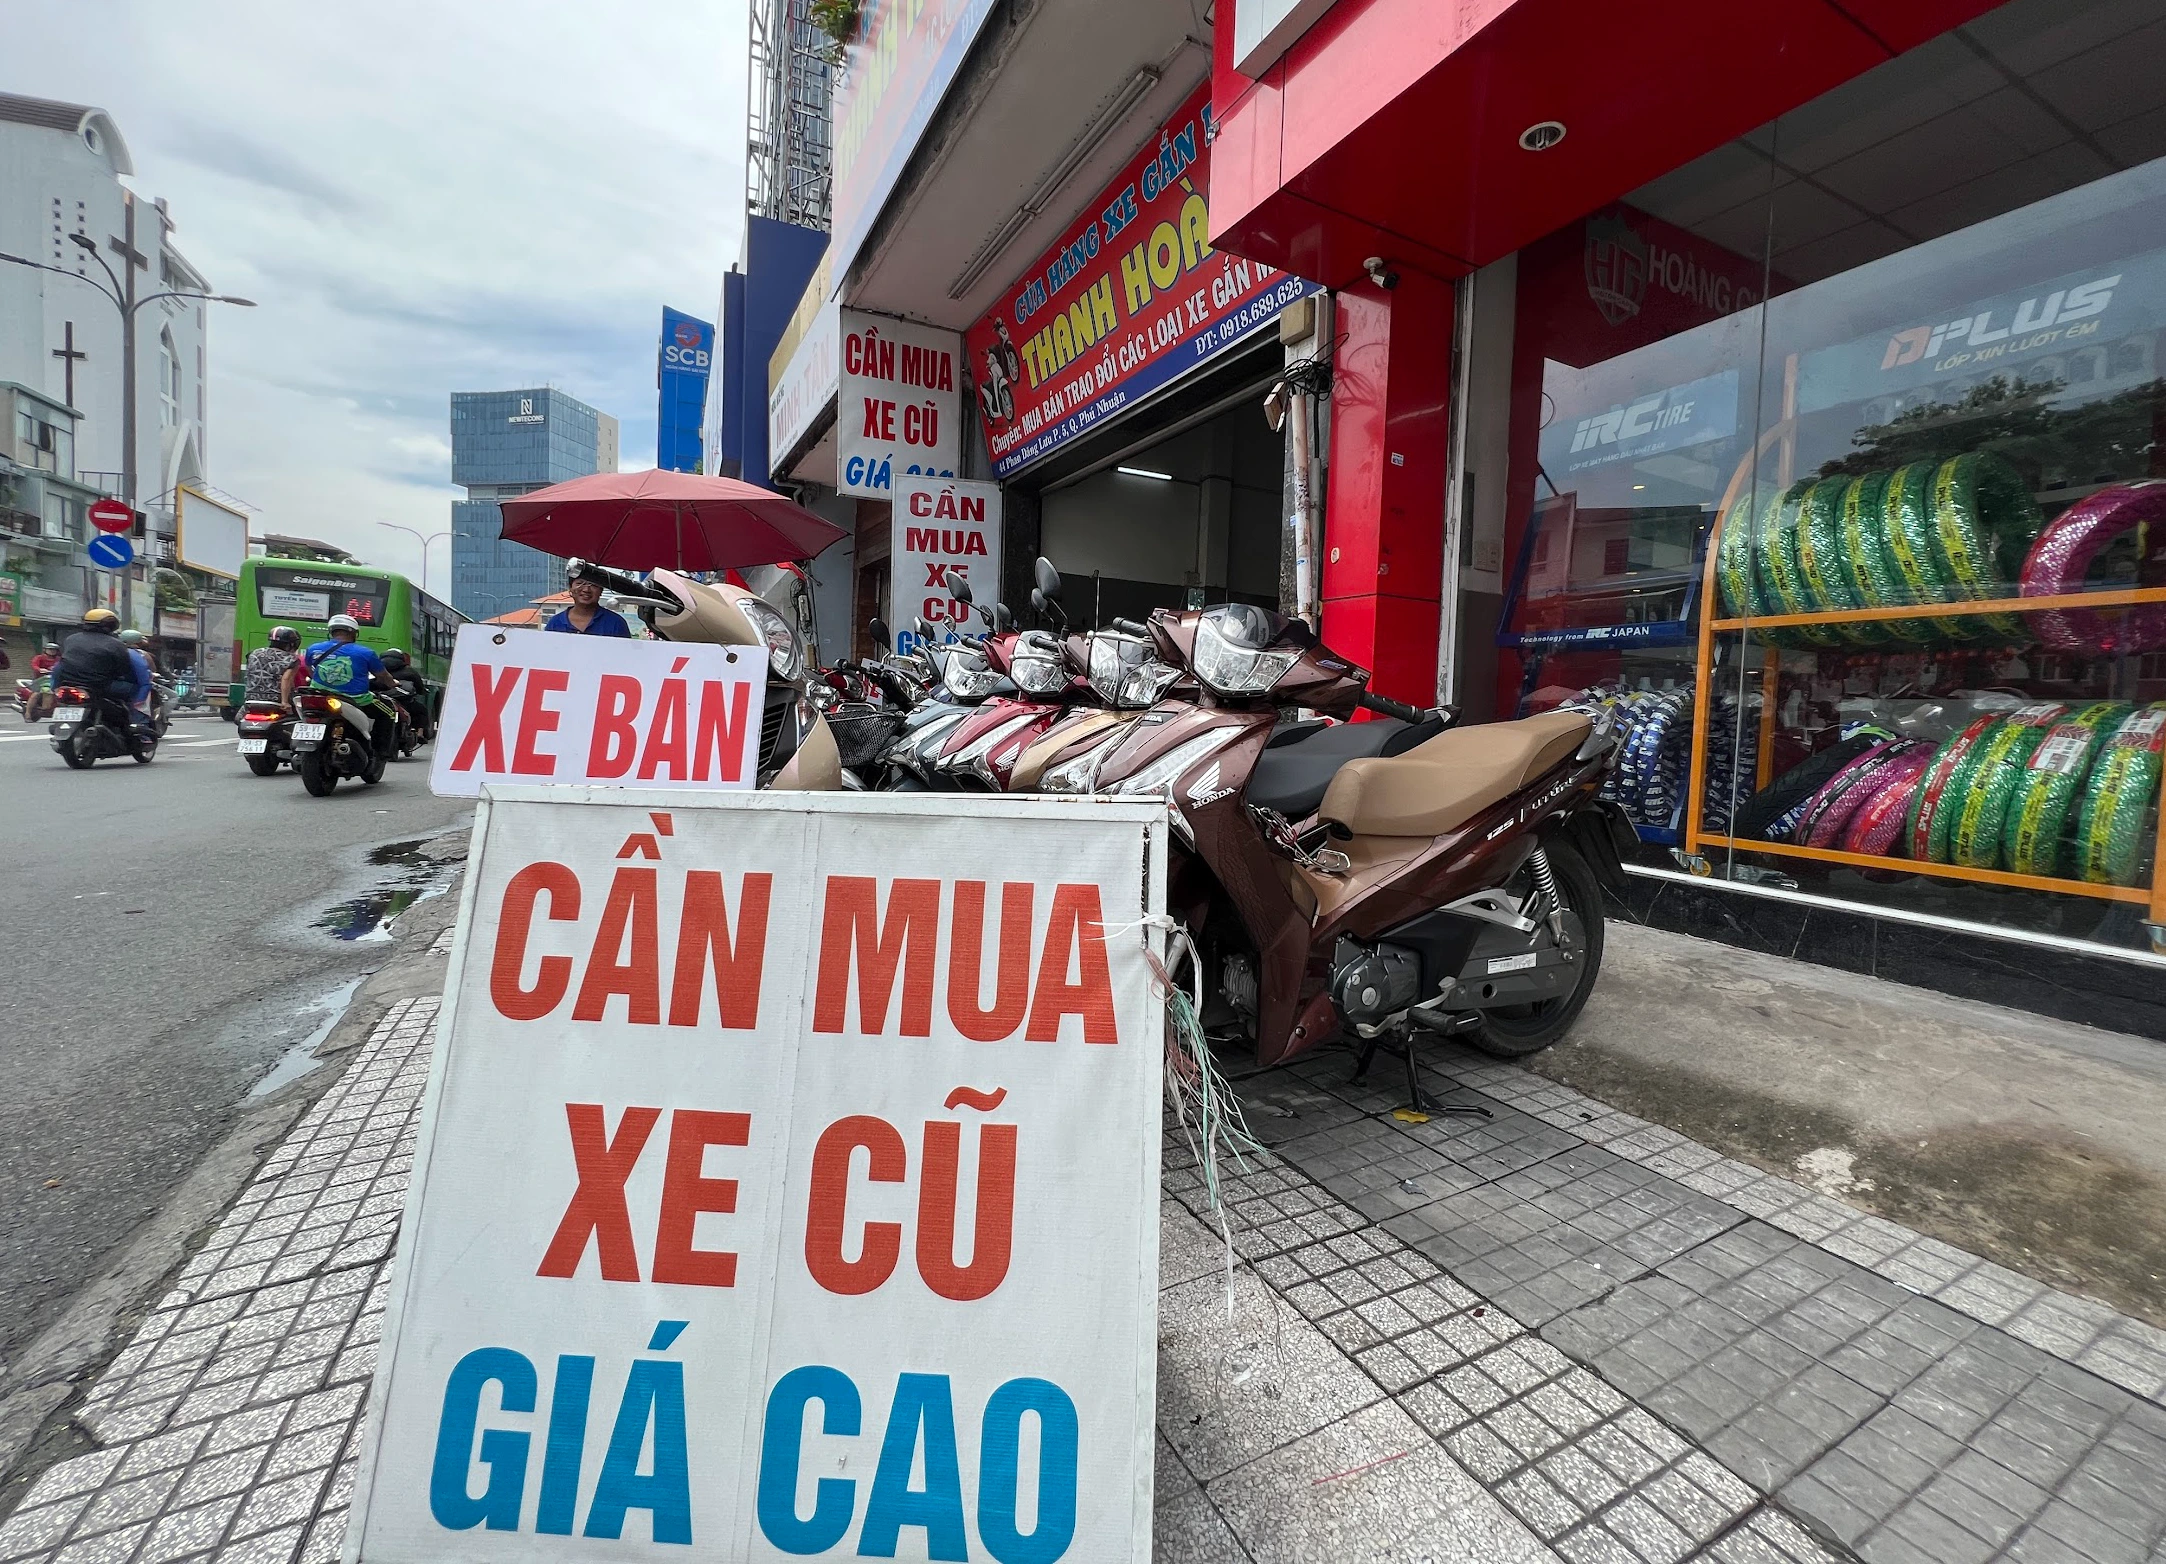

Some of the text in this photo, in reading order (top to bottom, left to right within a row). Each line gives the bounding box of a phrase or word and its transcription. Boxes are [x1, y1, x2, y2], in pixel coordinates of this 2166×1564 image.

[1015, 121, 1197, 324] CỬA HÀNG XE GẮN
[1021, 176, 1214, 390] THANH HOÀ
[1649, 244, 1731, 314] HOÀNG
[1195, 276, 1303, 356] ĐT: 0918.689.625
[1881, 274, 2122, 370] DPLUS
[665, 345, 709, 367] SCB
[845, 326, 895, 382] CẦN
[901, 344, 953, 392] MUA
[992, 425, 1022, 455] Chuyên:
[1022, 406, 1043, 436] MUA
[1043, 391, 1065, 423] BÁN
[1064, 370, 1094, 408] TRAO
[1095, 343, 1118, 389] ĐỔI
[1119, 333, 1146, 373] CÁC
[1148, 307, 1184, 346] LOẠI
[1187, 288, 1209, 329] XE
[1212, 255, 1250, 310] GẮN
[509, 415, 544, 423] NEWTECONS
[863, 397, 938, 447] XE CŨ
[1069, 419, 1079, 434] Q.
[1079, 406, 1096, 427] Phú
[1097, 391, 1126, 415] Nhuận
[1570, 397, 1696, 453] IRC TIRE
[846, 453, 893, 490] GIÁ
[909, 485, 986, 522] CẦN
[906, 527, 987, 556] MUA
[293, 576, 357, 589] SaigonBus
[924, 563, 969, 588] XE
[1520, 636, 1563, 644] Technology
[1612, 626, 1649, 638] JAPAN
[449, 656, 751, 782] XE BÁN
[1191, 787, 1236, 809] HONDA
[1918, 801, 1932, 832] DPLUS
[1487, 817, 1514, 841] 125
[489, 811, 1119, 1045] CẦN MUA
[535, 1086, 1018, 1302] XE CŨ
[429, 1320, 1079, 1564] GIÁ CAO
